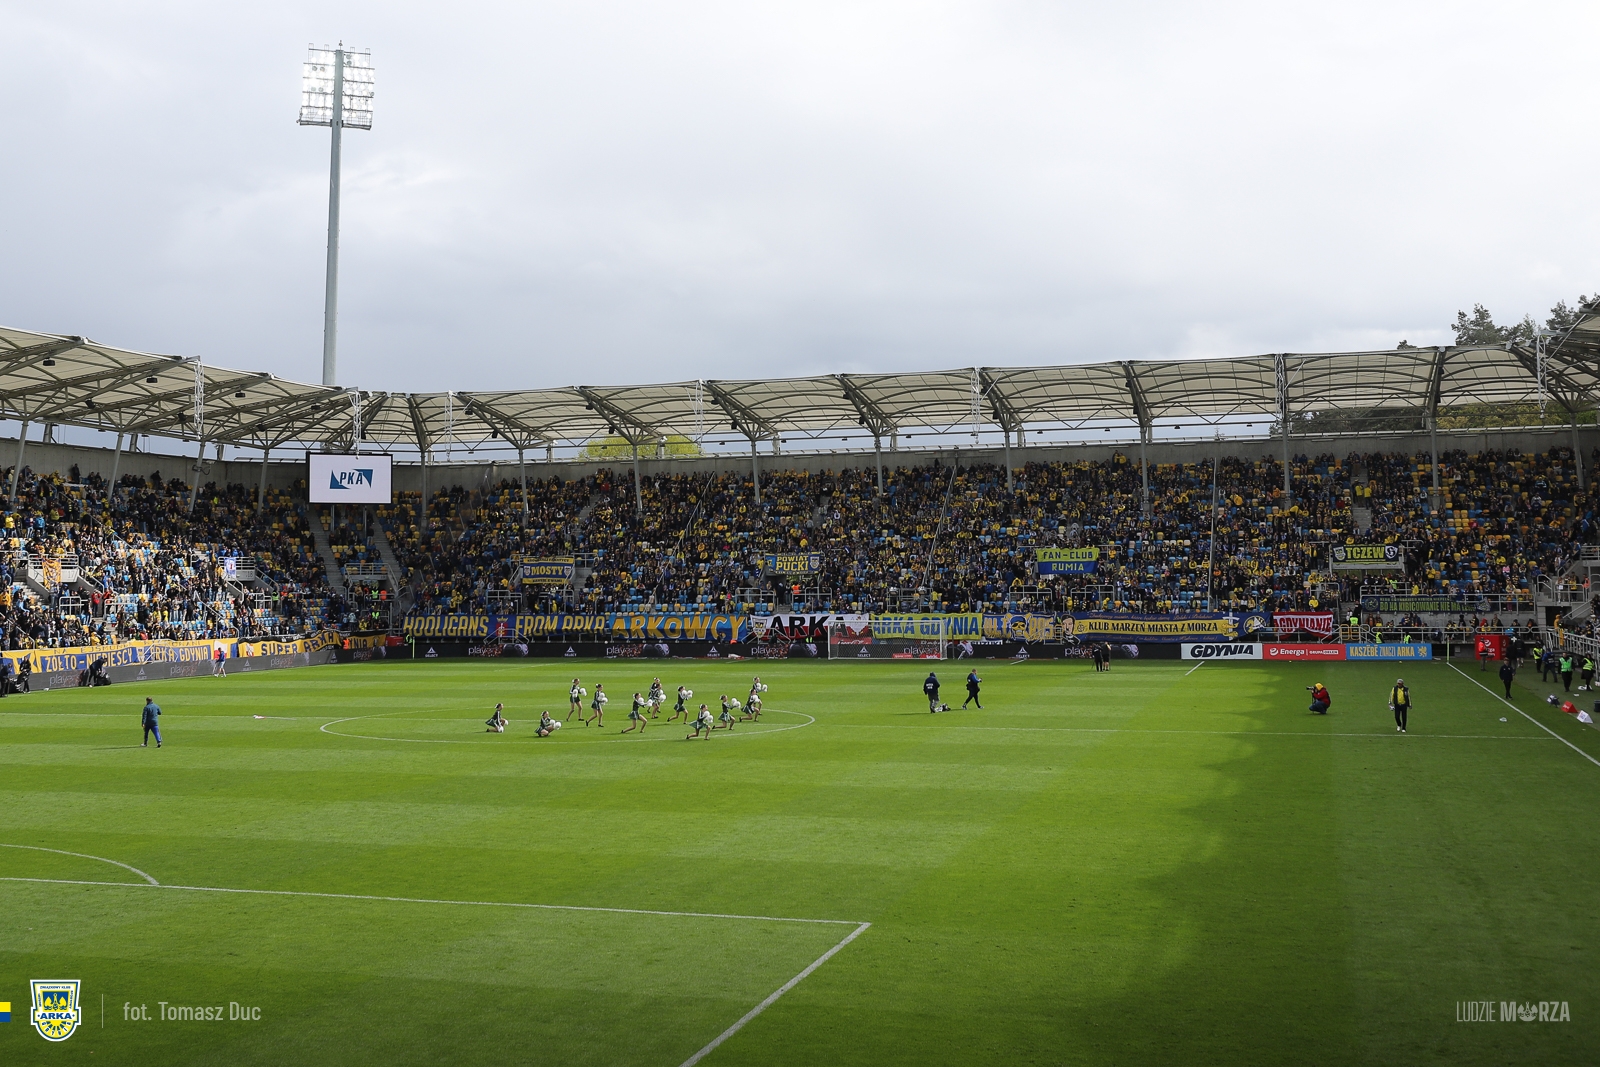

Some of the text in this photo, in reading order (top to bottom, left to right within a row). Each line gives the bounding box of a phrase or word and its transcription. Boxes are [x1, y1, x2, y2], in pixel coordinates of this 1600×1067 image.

[340, 471, 363, 485] PKA
[1043, 551, 1093, 559] FAN-CLUB
[1345, 546, 1385, 559] TCZEW
[531, 566, 563, 575] MOSTY
[776, 561, 809, 571] PUCKI
[1052, 563, 1084, 571] RUMIA
[403, 616, 489, 636] HOOLIGANS
[515, 615, 605, 637] FROM ARKA
[612, 615, 745, 640] ARKOWCY
[769, 615, 848, 637] ARKA
[872, 616, 979, 636] ARKA GDYNIA
[1089, 621, 1218, 632] KLUB MARZEŃ MIASTA Z MORZA
[179, 646, 208, 661] GDYNIA
[261, 643, 297, 656] SUPER
[1190, 644, 1254, 658] GDYNIA
[1280, 648, 1304, 656] Energa
[1397, 646, 1415, 656] ARKA
